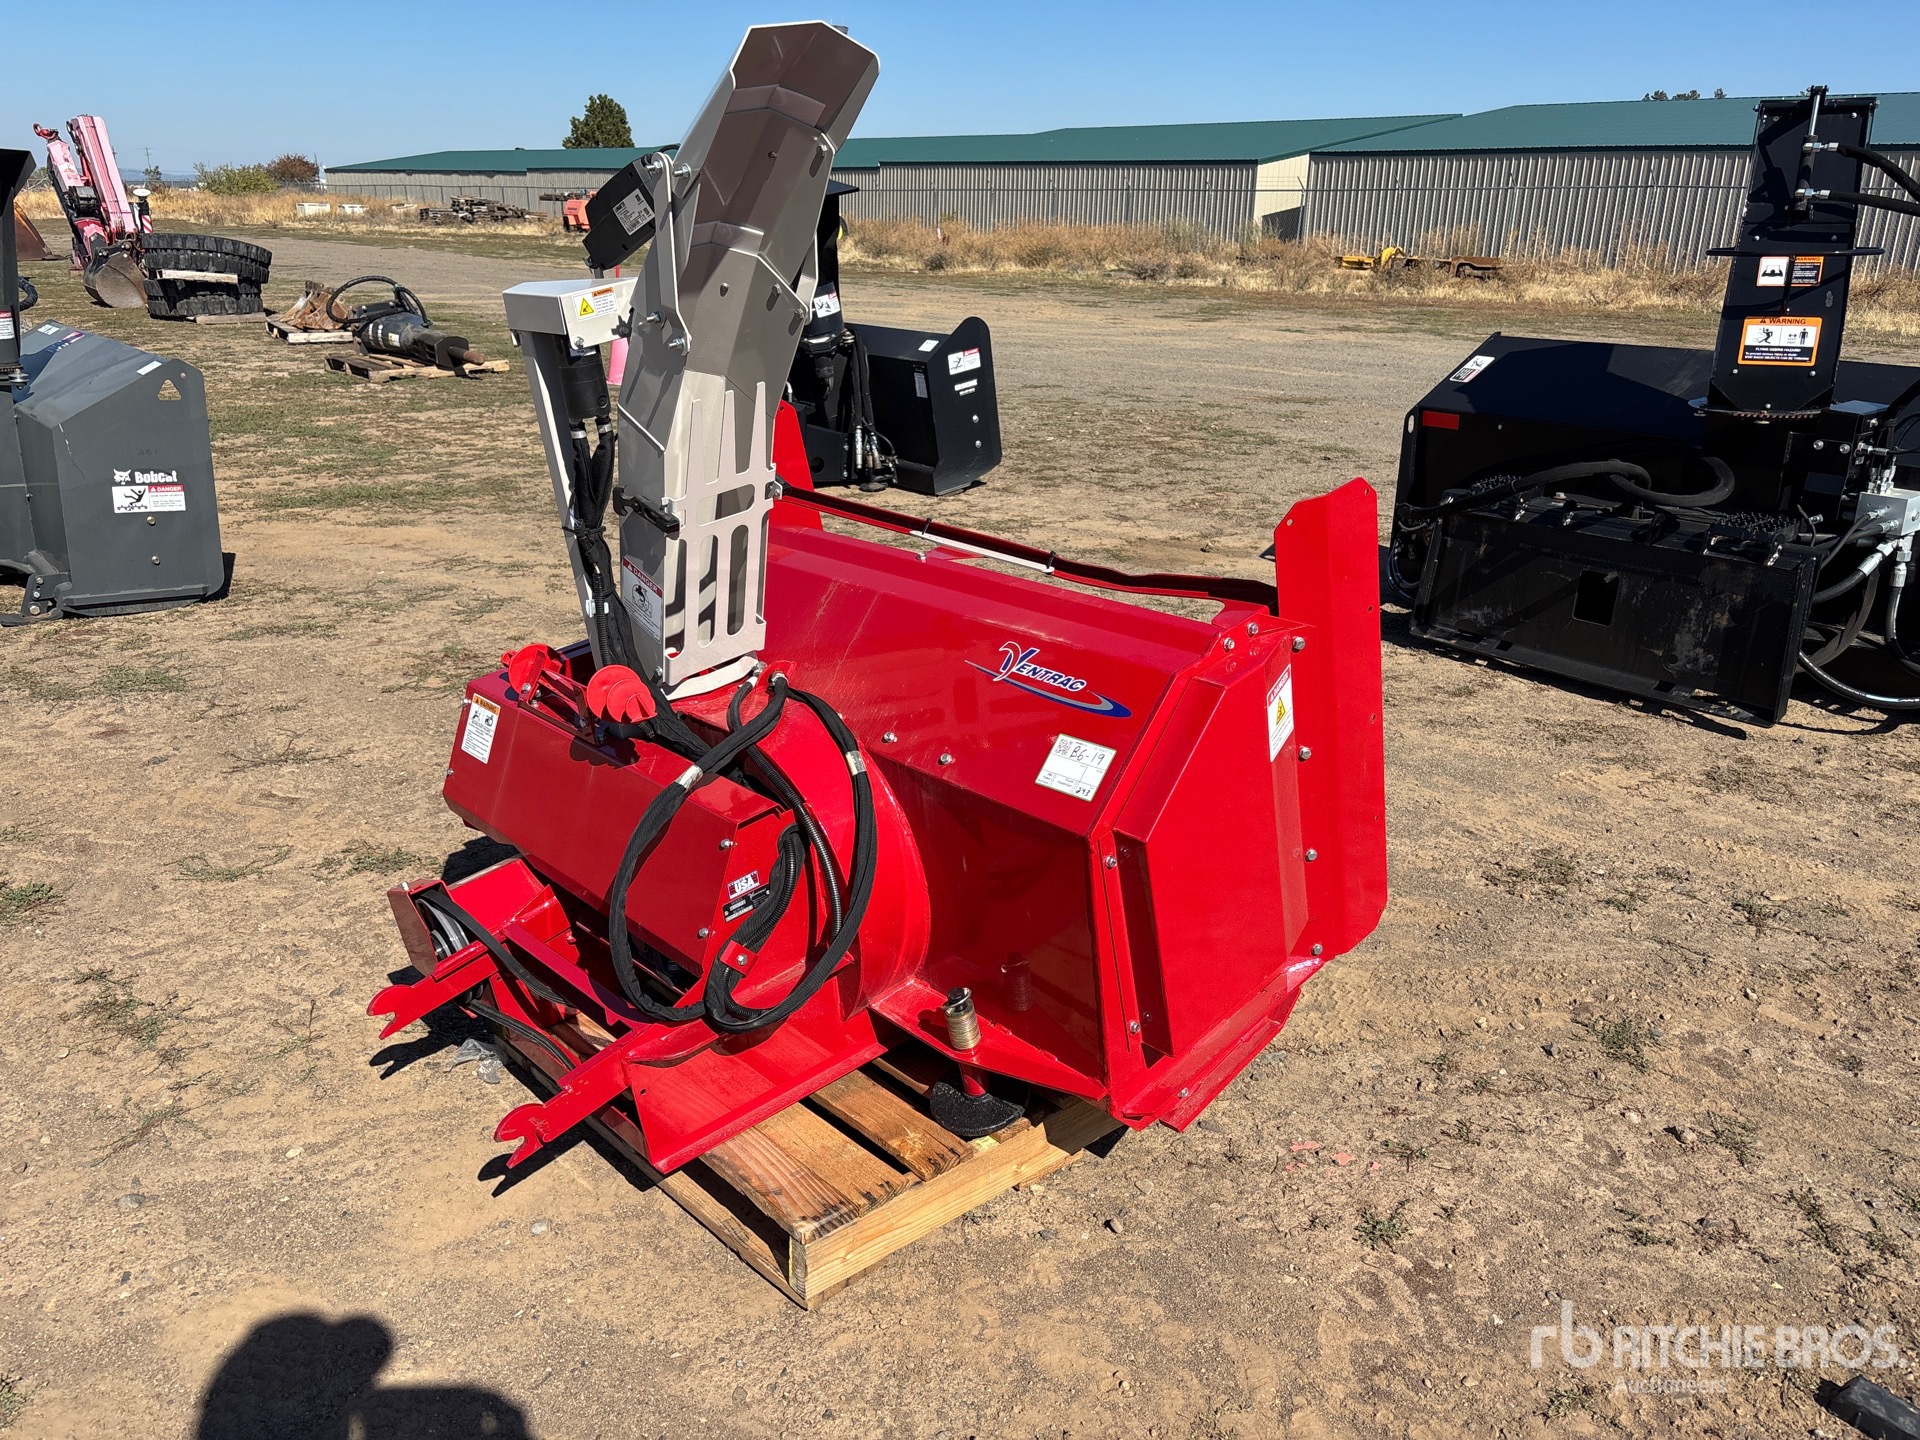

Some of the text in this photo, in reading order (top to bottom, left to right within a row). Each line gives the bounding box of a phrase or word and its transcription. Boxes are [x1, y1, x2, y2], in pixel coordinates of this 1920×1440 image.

[134, 470, 178, 483] Bobcat
[633, 568, 659, 593] DANGER
[733, 875, 755, 893] USA
